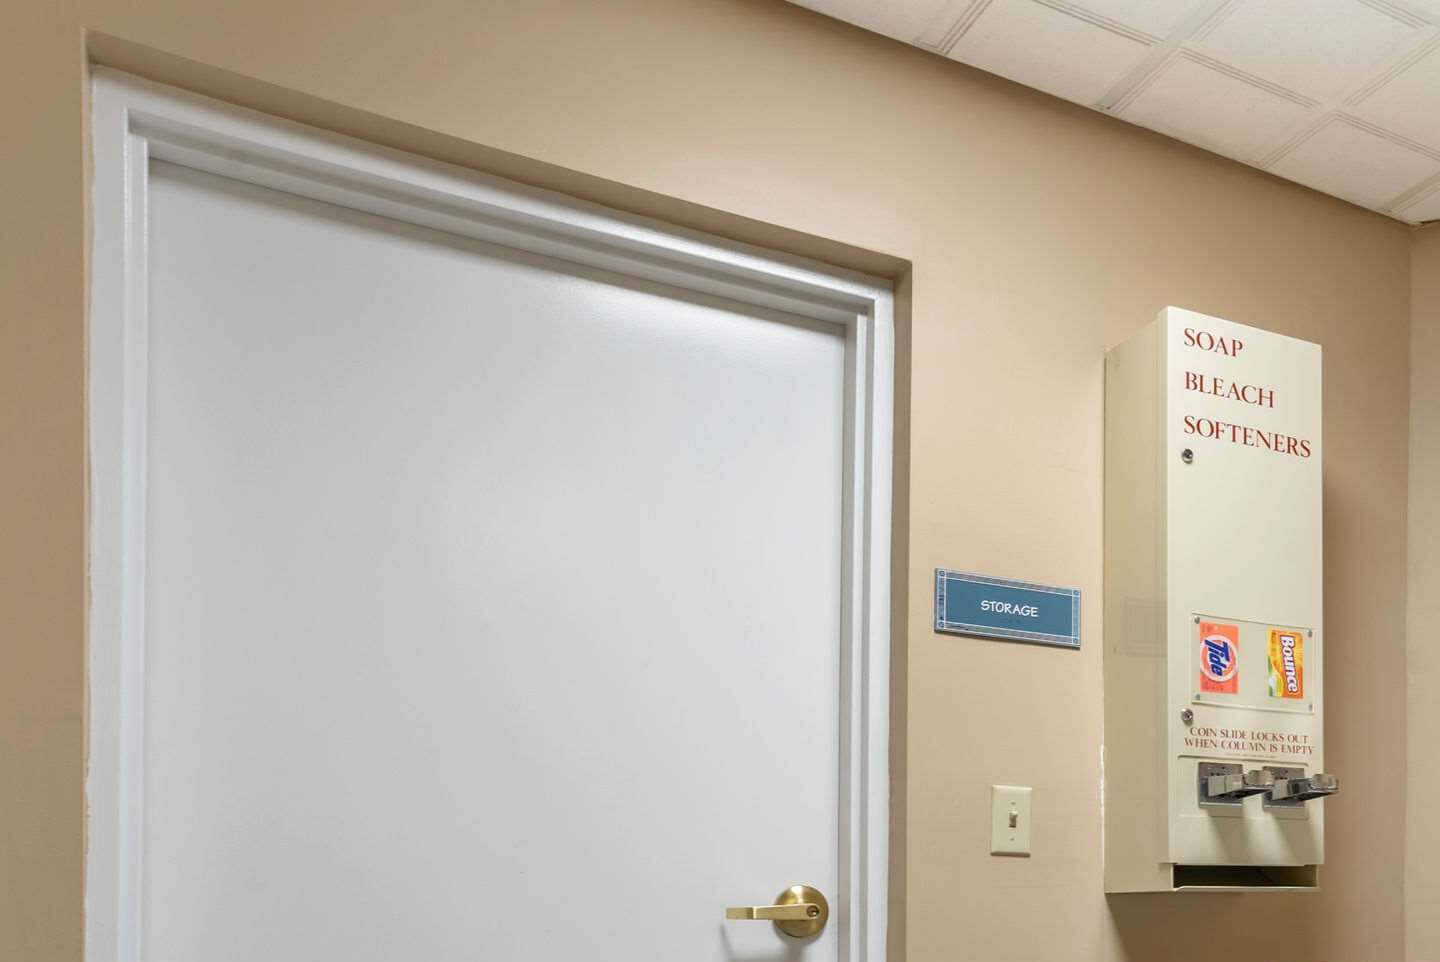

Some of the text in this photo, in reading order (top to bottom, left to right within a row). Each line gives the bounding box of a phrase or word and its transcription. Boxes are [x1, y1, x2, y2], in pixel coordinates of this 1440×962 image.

[1183, 328, 1243, 357] SOAP
[1185, 371, 1275, 408] BLEACH
[1183, 415, 1311, 458] SOFTENERS
[980, 600, 1039, 617] STORAGE
[1204, 639, 1230, 676] Tide
[1280, 634, 1298, 693] Bounce
[1184, 737, 1313, 755] WHEN COLUMN IS EMPTY
[1190, 727, 1308, 744] COIN SLIDE LOCKS OUT
